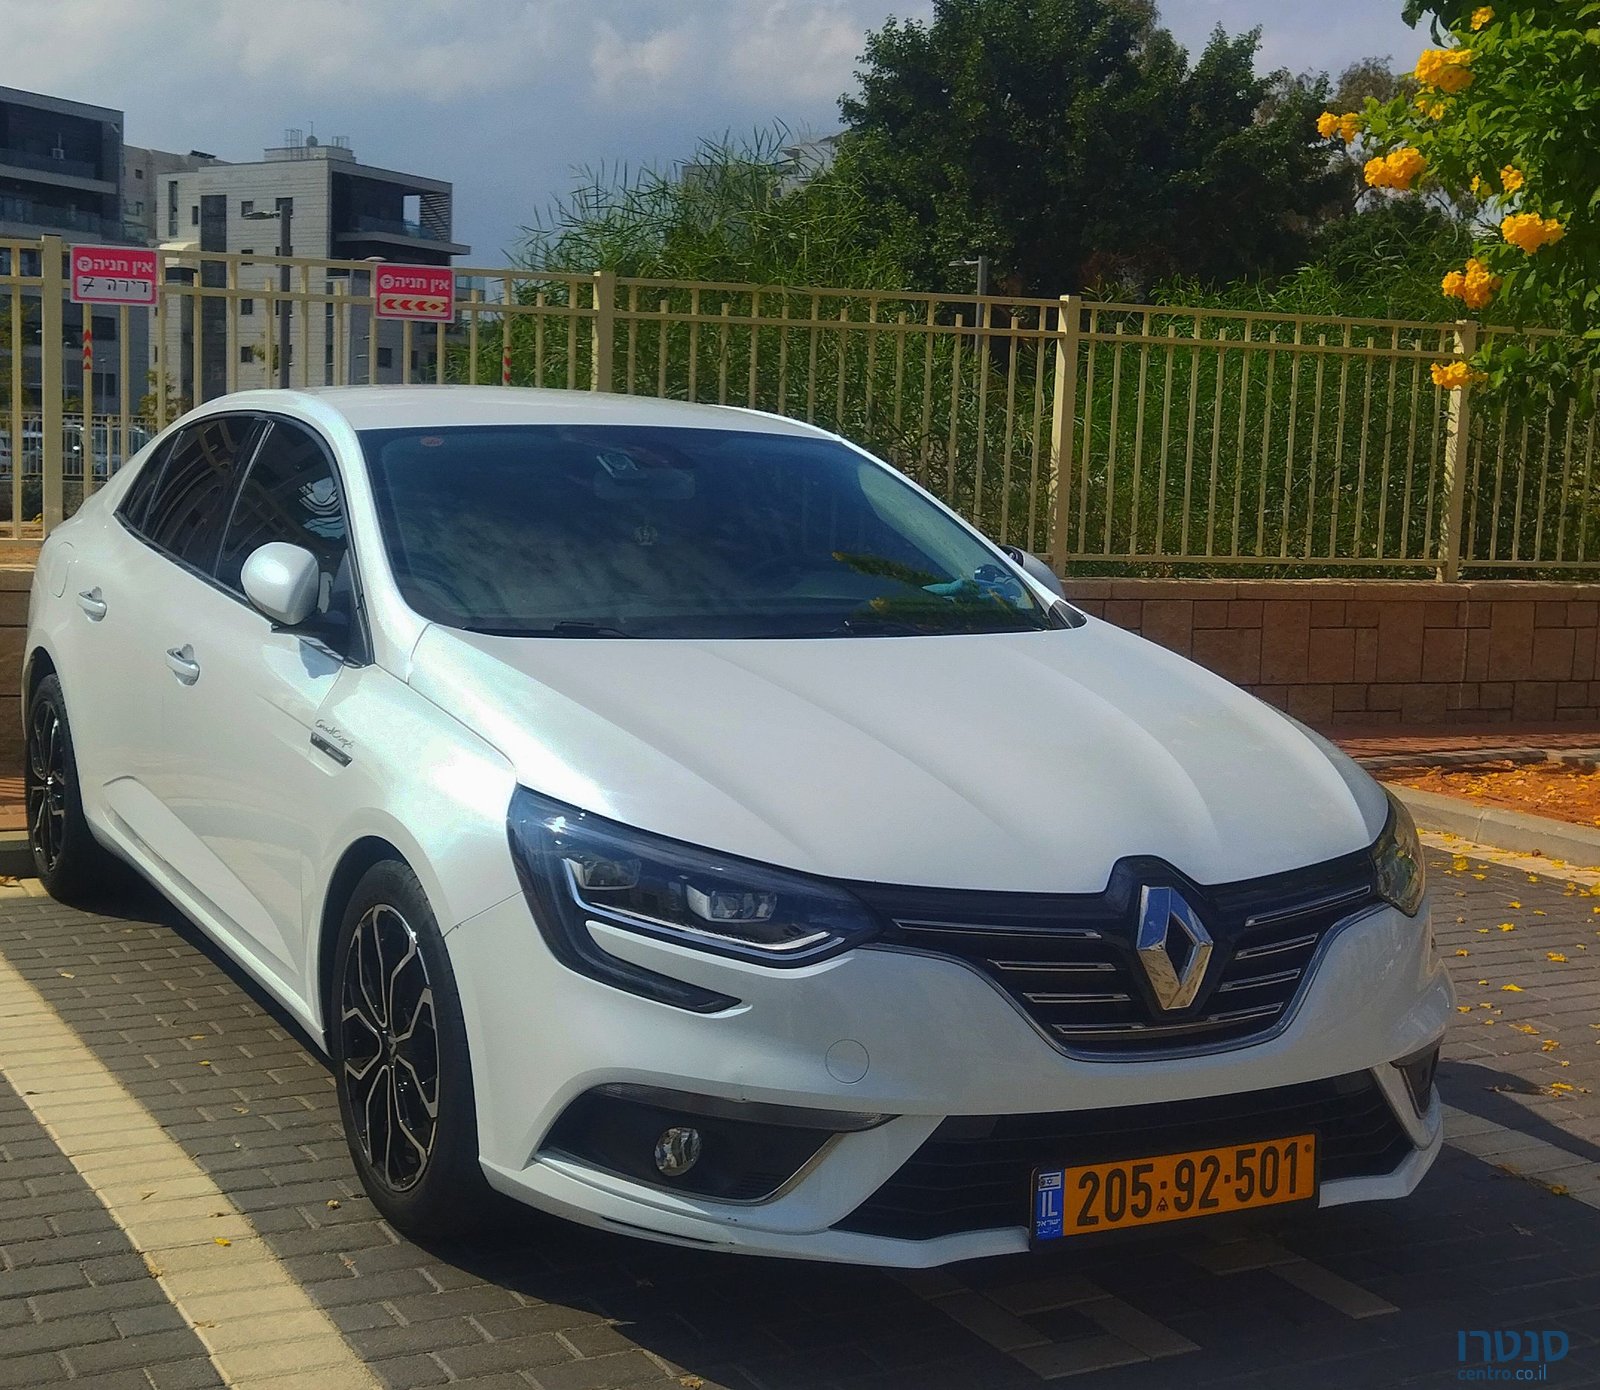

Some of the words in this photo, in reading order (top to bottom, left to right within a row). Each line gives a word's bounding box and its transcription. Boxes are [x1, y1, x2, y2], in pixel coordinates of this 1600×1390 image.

[93, 258, 128, 271] חניה
[132, 261, 153, 275] אין
[82, 276, 95, 292] 7
[105, 278, 148, 293] דירה
[394, 276, 427, 289] חניה
[430, 278, 450, 292] אין
[1041, 1190, 1058, 1217] IL
